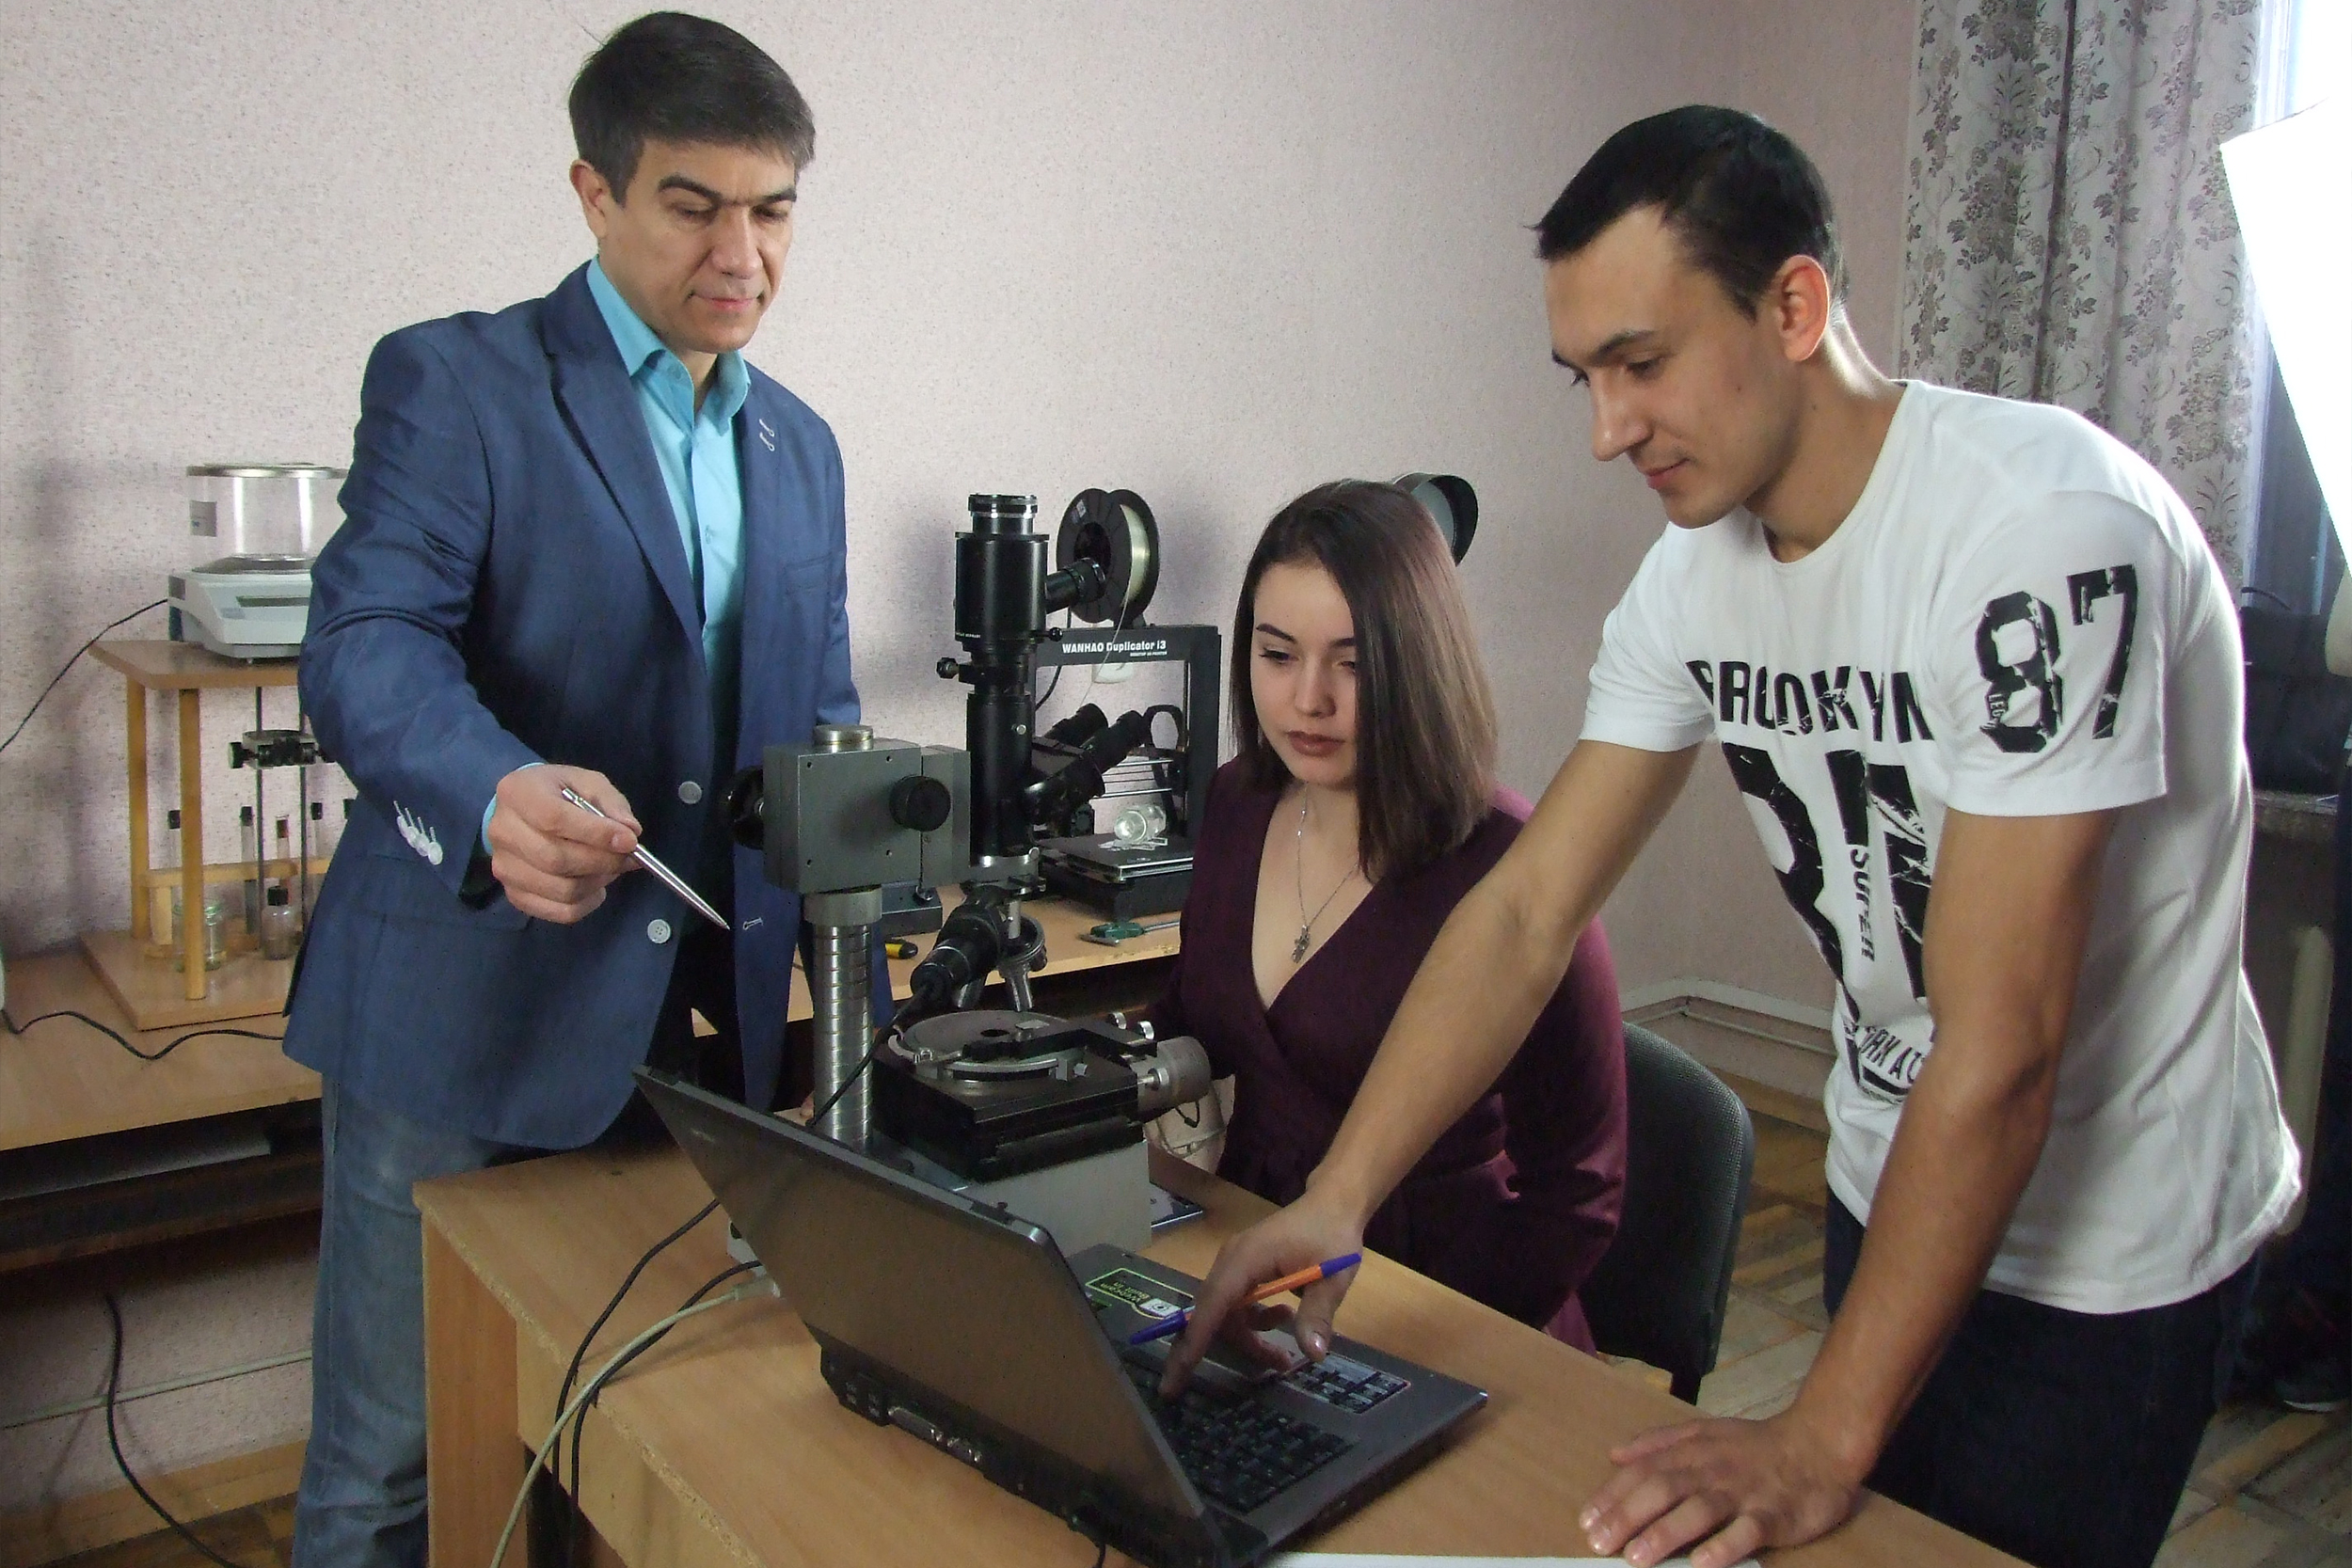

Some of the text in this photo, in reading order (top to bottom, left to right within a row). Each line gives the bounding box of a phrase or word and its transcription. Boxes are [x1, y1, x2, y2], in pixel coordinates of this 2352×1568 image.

[1062, 640, 1167, 654] WANHAO Duplicator i3
[1974, 562, 2138, 753] 87
